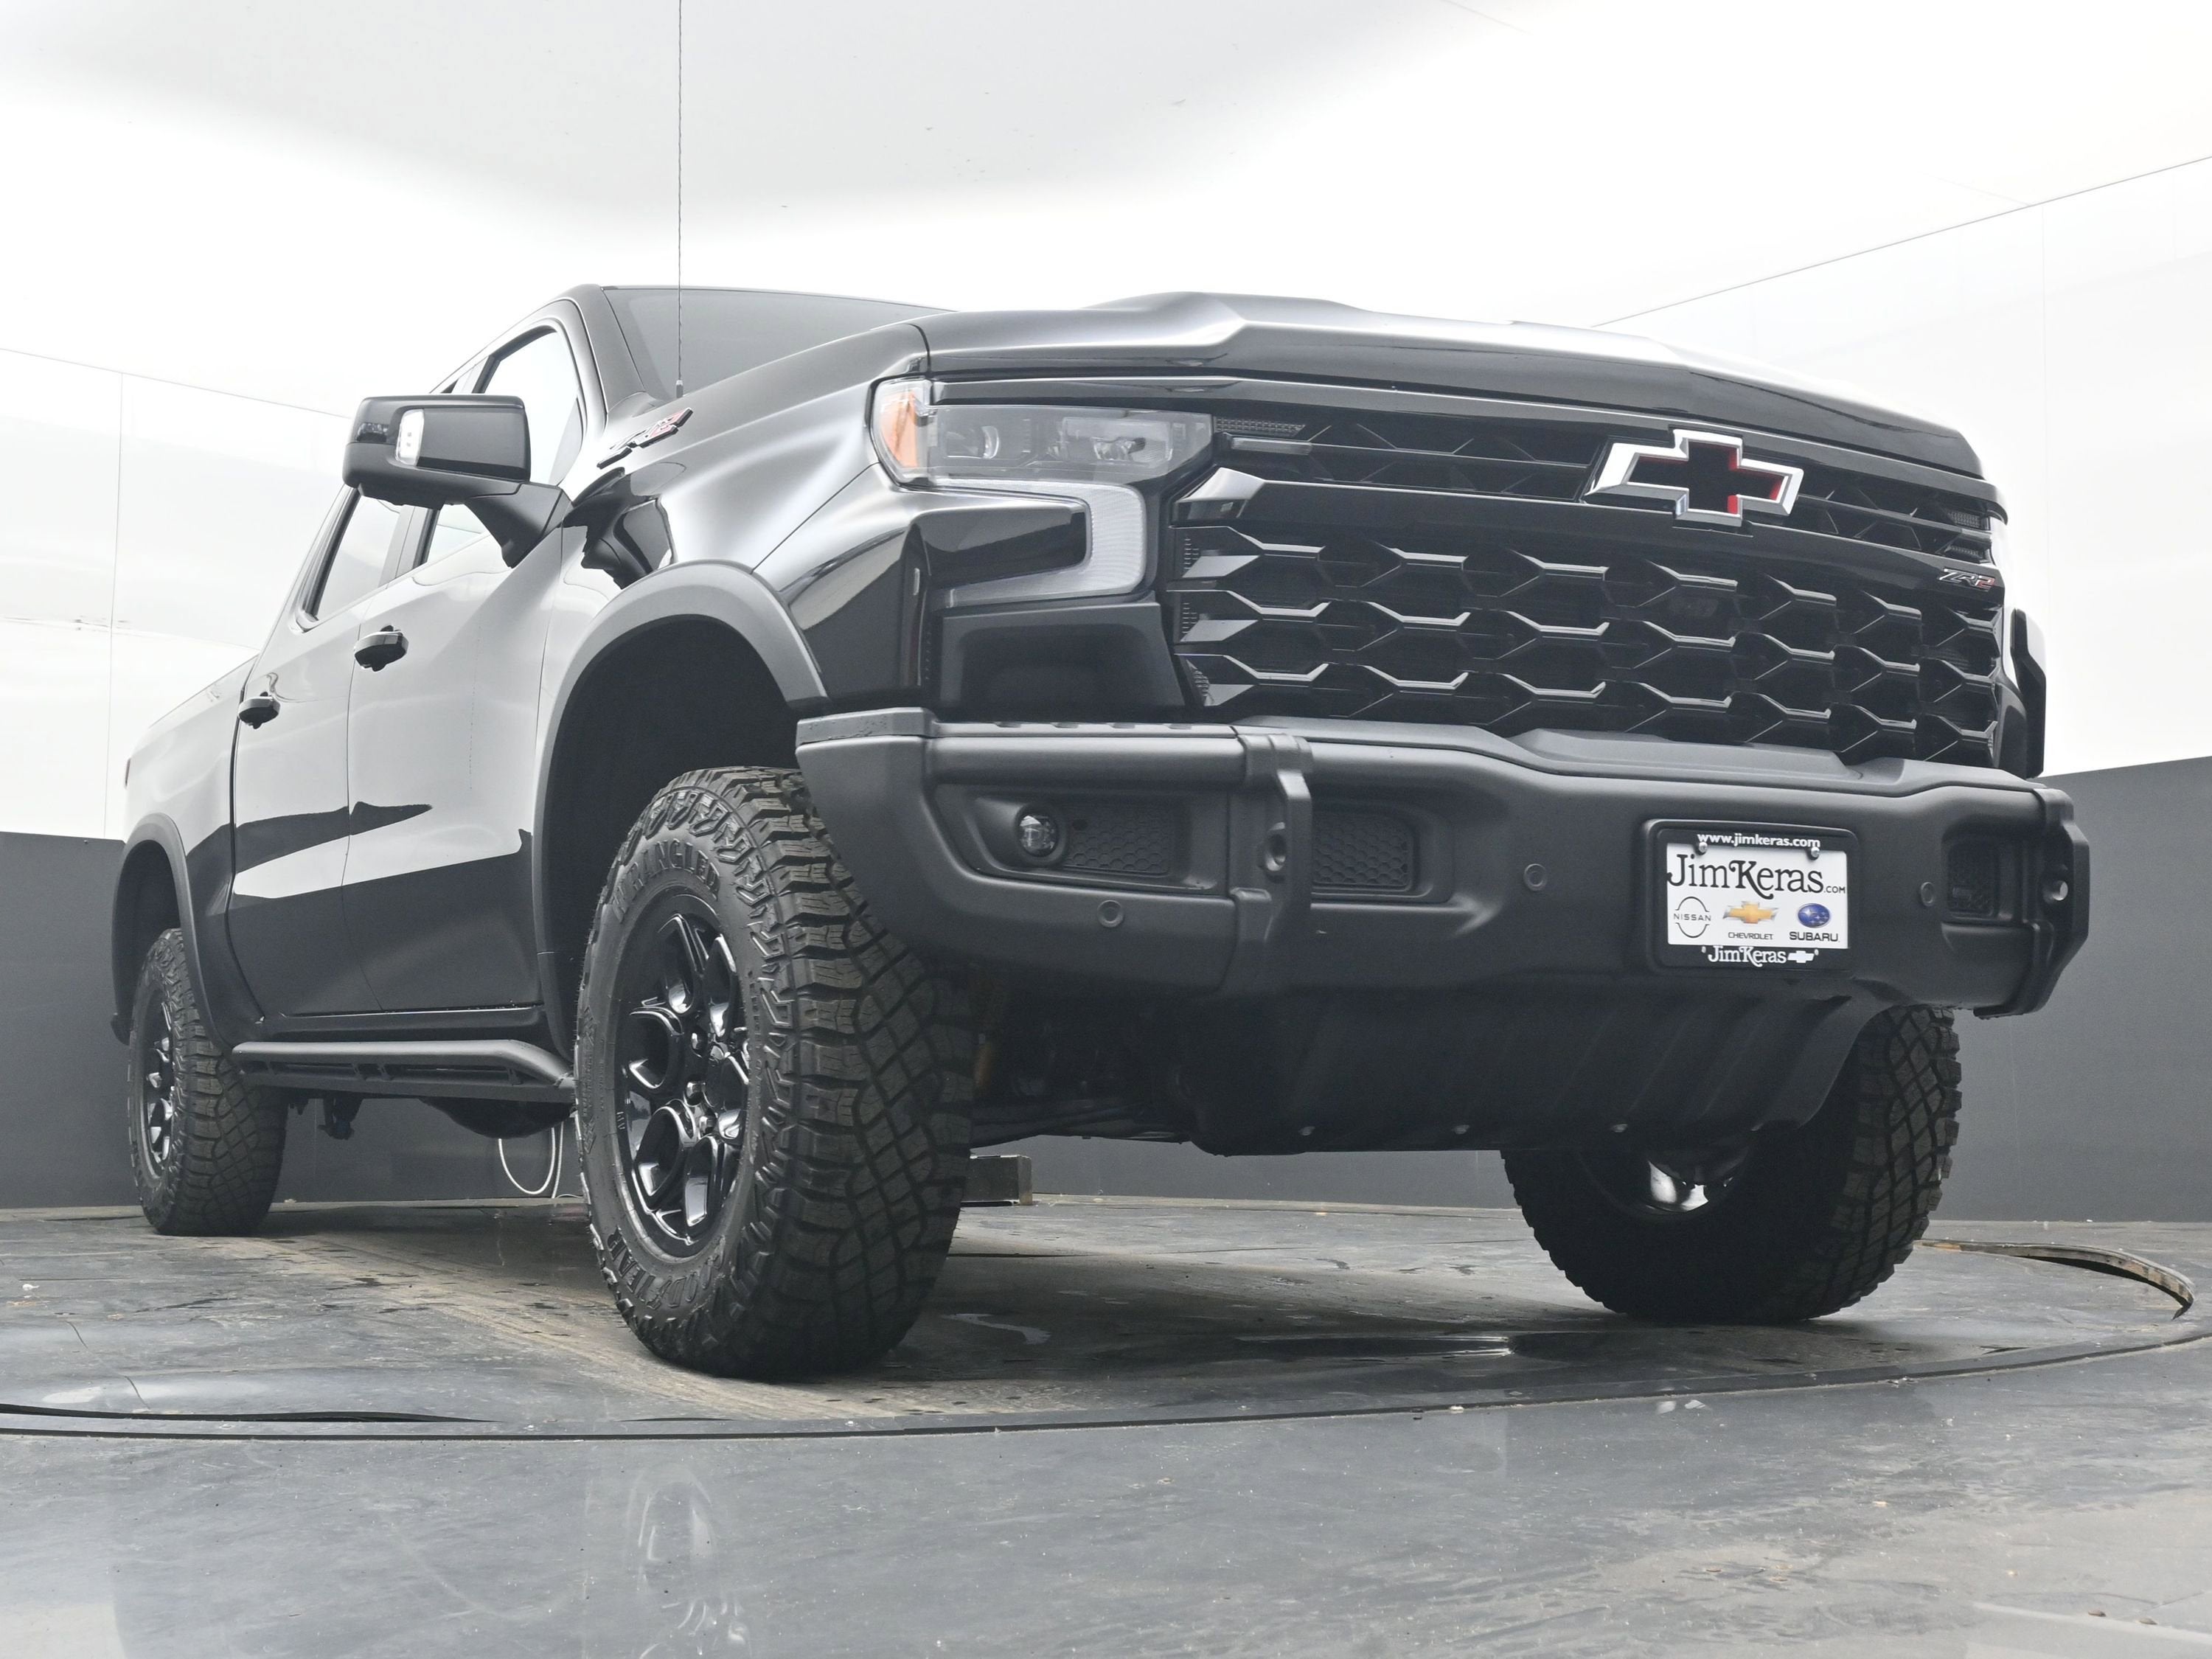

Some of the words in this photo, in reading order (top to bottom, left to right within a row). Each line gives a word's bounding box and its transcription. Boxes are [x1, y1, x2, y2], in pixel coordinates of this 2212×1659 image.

[1937, 568, 1996, 591] ZR2
[1697, 833, 1820, 848] www.jimkeras.com
[1673, 913, 1711, 922] NISSAN
[1728, 932, 1773, 940] CHEVROLET
[1789, 931, 1838, 942] SUBARU
